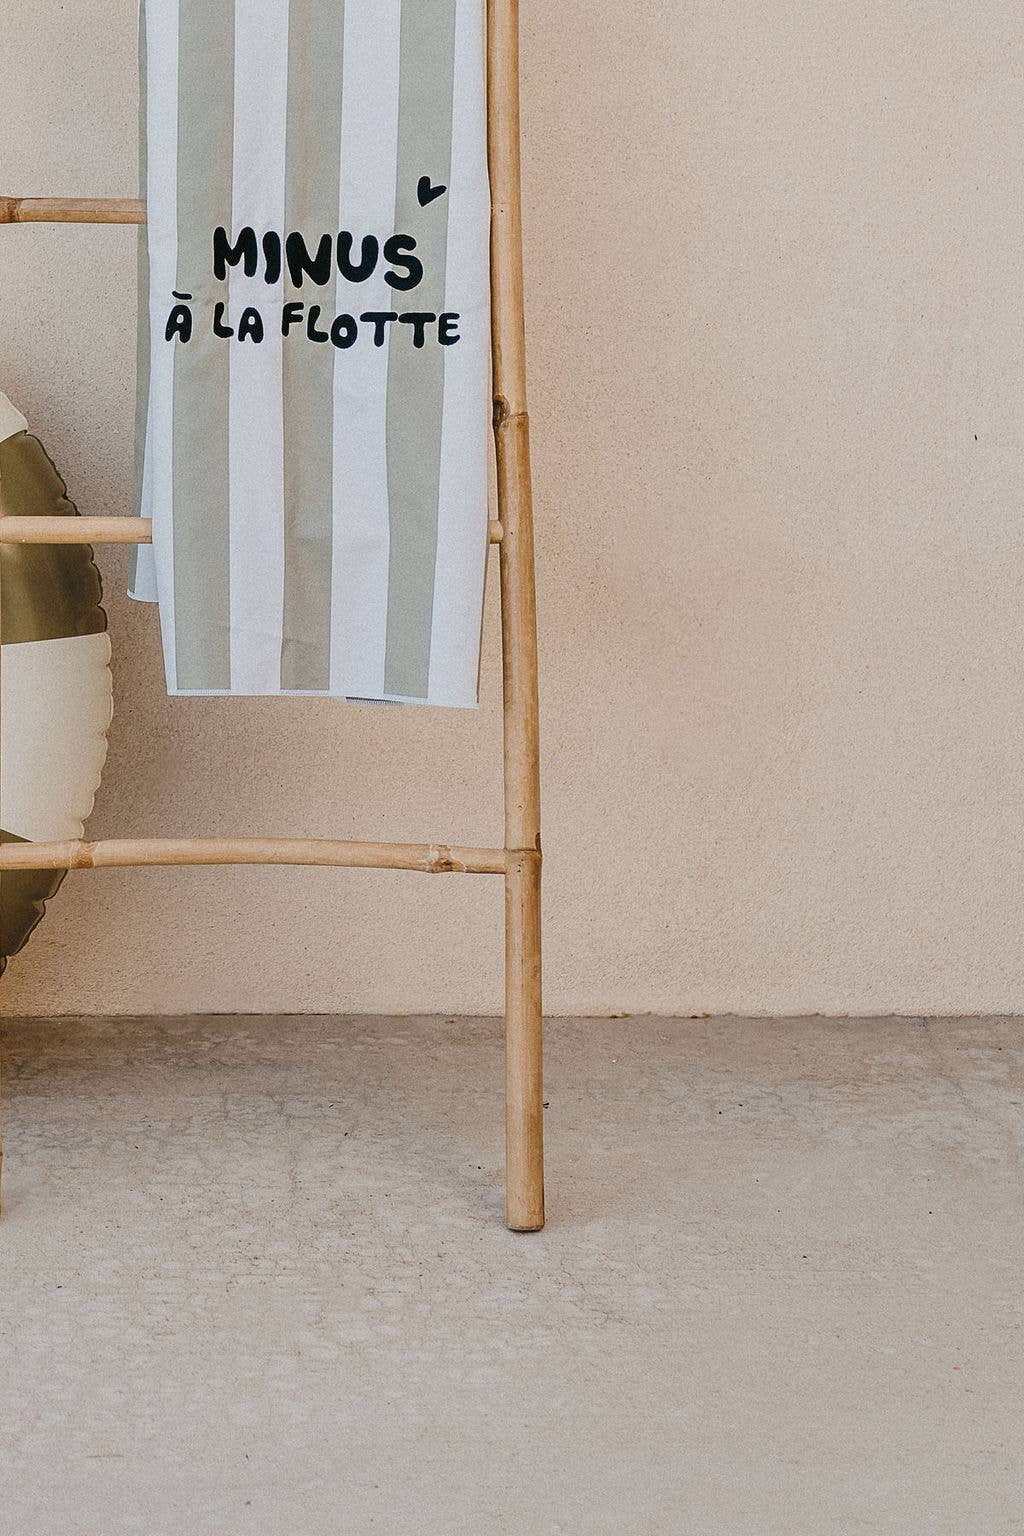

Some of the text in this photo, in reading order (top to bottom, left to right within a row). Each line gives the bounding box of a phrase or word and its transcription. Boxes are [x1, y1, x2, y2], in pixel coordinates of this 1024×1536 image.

[213, 226, 424, 292] MINUS
[164, 290, 461, 350] À LA FLOTTE
